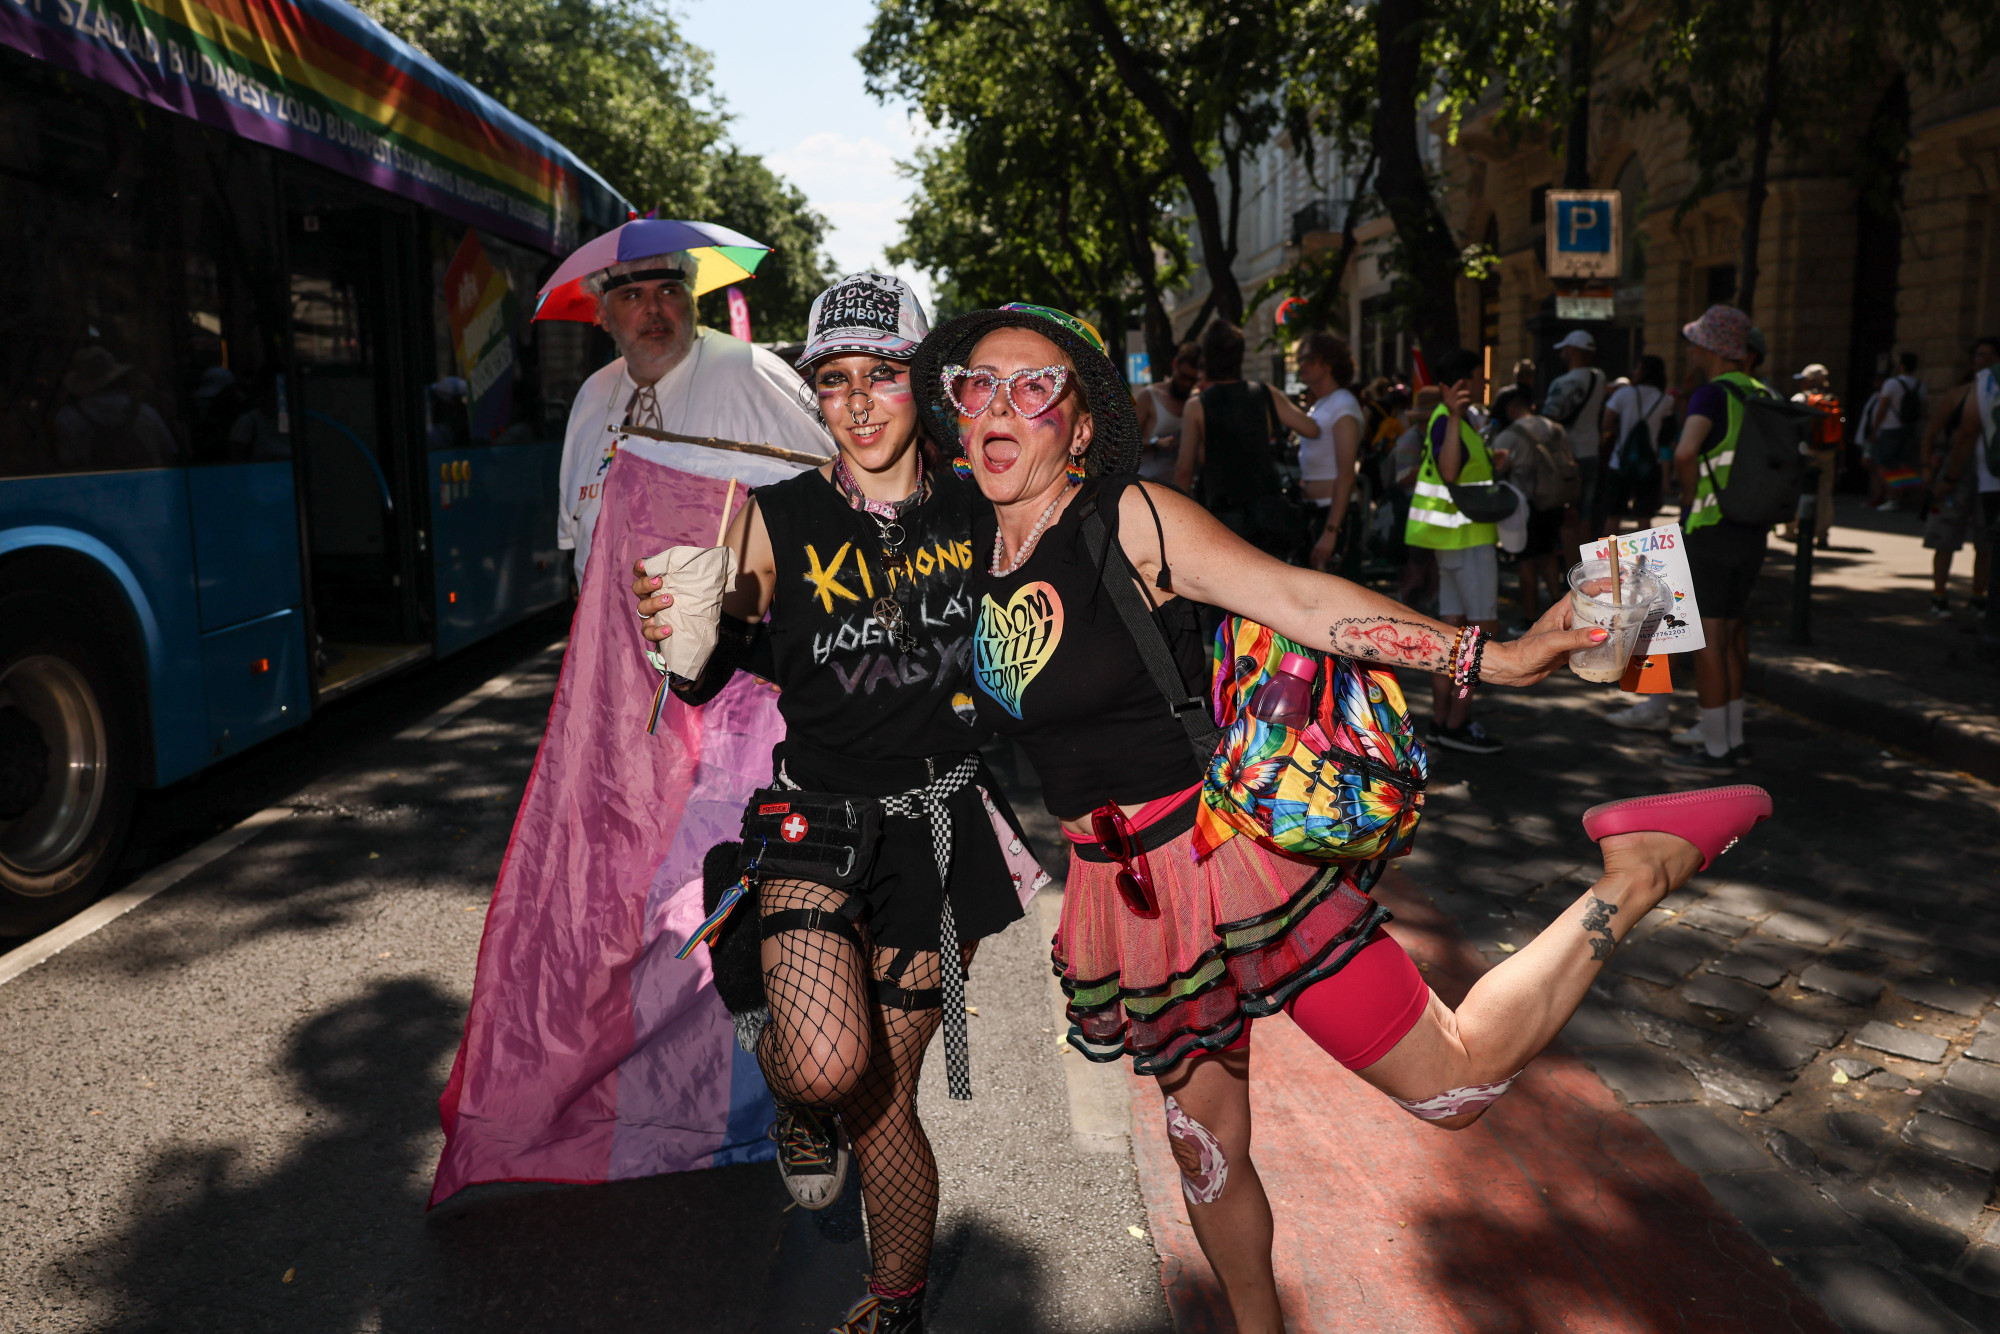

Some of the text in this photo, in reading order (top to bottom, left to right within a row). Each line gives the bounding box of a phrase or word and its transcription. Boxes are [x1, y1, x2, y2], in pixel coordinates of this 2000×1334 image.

[58, 0, 160, 64] SZABAD
[167, 38, 272, 114] BUDAPEST
[325, 112, 392, 165] BUDAPEST
[1570, 206, 1597, 245] P
[836, 287, 882, 301] LOVE
[837, 299, 875, 310] CUTE
[824, 307, 895, 326] FEMBOYS
[578, 483, 600, 501] BU
[803, 539, 973, 614] KI MOND
[976, 619, 1053, 670] WITH
[979, 659, 1037, 714] PRIDE
